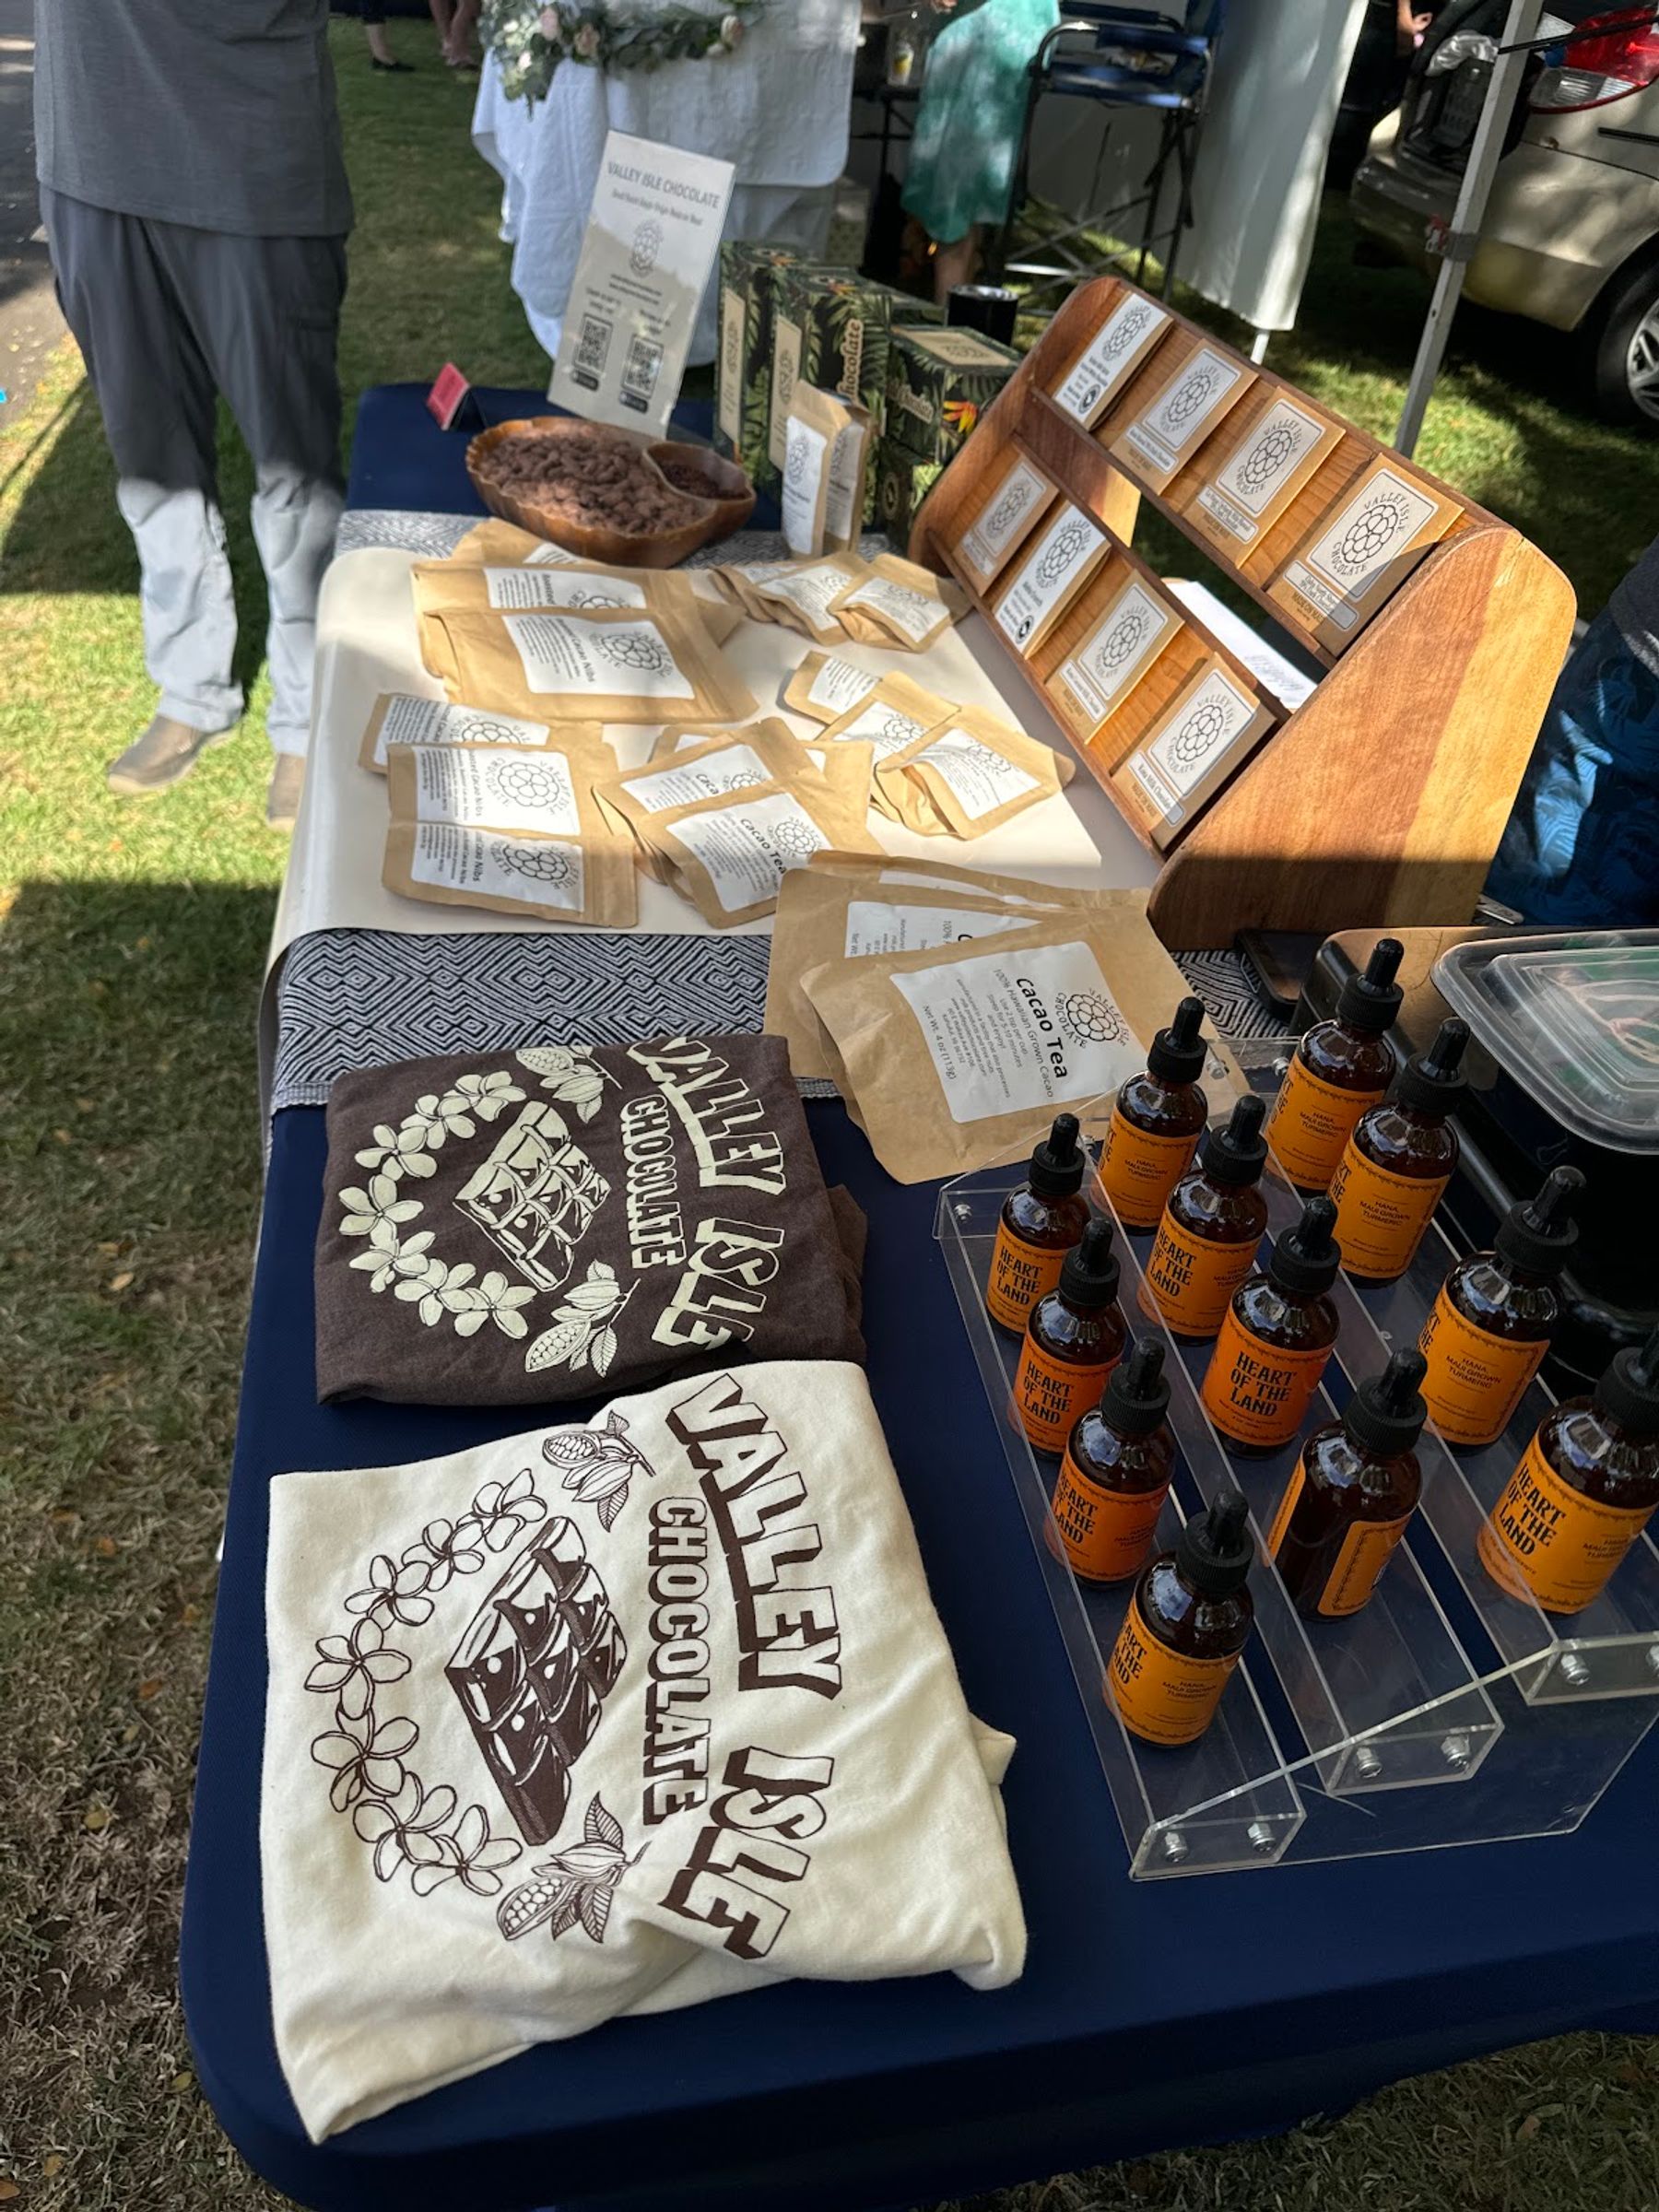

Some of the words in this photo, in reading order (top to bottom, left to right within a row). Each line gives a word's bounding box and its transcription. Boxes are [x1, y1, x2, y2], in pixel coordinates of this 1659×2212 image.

[608, 161, 642, 182] VALLEY
[642, 173, 663, 190] ISLE
[663, 180, 721, 208] CHOCOLATE
[841, 322, 861, 396] hocolate
[1364, 493, 1406, 510] VALLEY
[1396, 504, 1410, 533] ISLE
[1331, 542, 1368, 576] CHOCOLATE
[581, 662, 597, 682] Nibs
[1197, 694, 1233, 707] VALLEY
[471, 774, 481, 795] Cacao
[695, 773, 719, 795] Caca
[474, 796, 483, 817] Nibs
[739, 818, 771, 850] Cacao
[769, 851, 786, 875] Tea
[473, 861, 483, 883] Nibs
[924, 1005, 934, 1018] Net
[964, 1009, 979, 1034] products
[1055, 992, 1088, 1049] CHOCOLATE
[1088, 987, 1125, 1025] VALLEY
[987, 994, 999, 1011] Steep
[1002, 1023, 1012, 1038] 5-10
[1007, 1039, 1022, 1067] minutes
[987, 1015, 997, 1027] and
[994, 1029, 1006, 1049] enjoy!
[993, 970, 1011, 989] 100%
[1007, 989, 1031, 1029] Hawaiian
[1028, 1030, 1044, 1064] Grown
[1040, 1065, 1053, 1098] Cacao
[1017, 978, 1053, 1031] Cacao
[1047, 1037, 1067, 1078] Tea
[937, 1041, 947, 1052] oz
[1018, 1042, 1028, 1055] cup
[941, 1053, 957, 1080] (113g)
[996, 1066, 1011, 1098] processes
[625, 1036, 786, 1195] VALLEY
[1301, 1121, 1336, 1137] TURMERIC
[620, 1092, 688, 1270] CHOCOLATE
[1362, 1210, 1403, 1226] TURMERIC
[1000, 1246, 1043, 1278] HEART
[1159, 1227, 1196, 1269] HEART
[651, 1217, 785, 1349] ISLE
[997, 1260, 1007, 1277] OF
[1014, 1273, 1041, 1293] THE
[1150, 1259, 1180, 1297] LAND
[1164, 1257, 1194, 1286] THE
[997, 1277, 1030, 1305] LAND
[1027, 1360, 1075, 1398] HEART
[1230, 1368, 1253, 1388] OF
[1255, 1382, 1292, 1402] THE
[1237, 1351, 1298, 1385] HEART
[1446, 1356, 1465, 1372] MAUI
[1466, 1369, 1501, 1384] GROWN
[1448, 1367, 1493, 1389] TURMERIC
[1024, 1376, 1037, 1394] OF
[1041, 1390, 1072, 1412] THE
[1024, 1393, 1061, 1425] LAND
[1230, 1386, 1277, 1417] LAND
[1518, 1463, 1566, 1525] HEART
[1054, 1504, 1084, 1544] LAND
[1067, 1502, 1096, 1535] THE
[1499, 1502, 1537, 1555] LAND
[1508, 1480, 1523, 1505] OF
[1519, 1503, 1557, 1547] THE
[665, 1373, 843, 1700] VALLEY
[642, 1496, 712, 1827] CHOCOLATE
[1121, 1643, 1143, 1679] THE
[657, 1745, 836, 1959] ISLE
